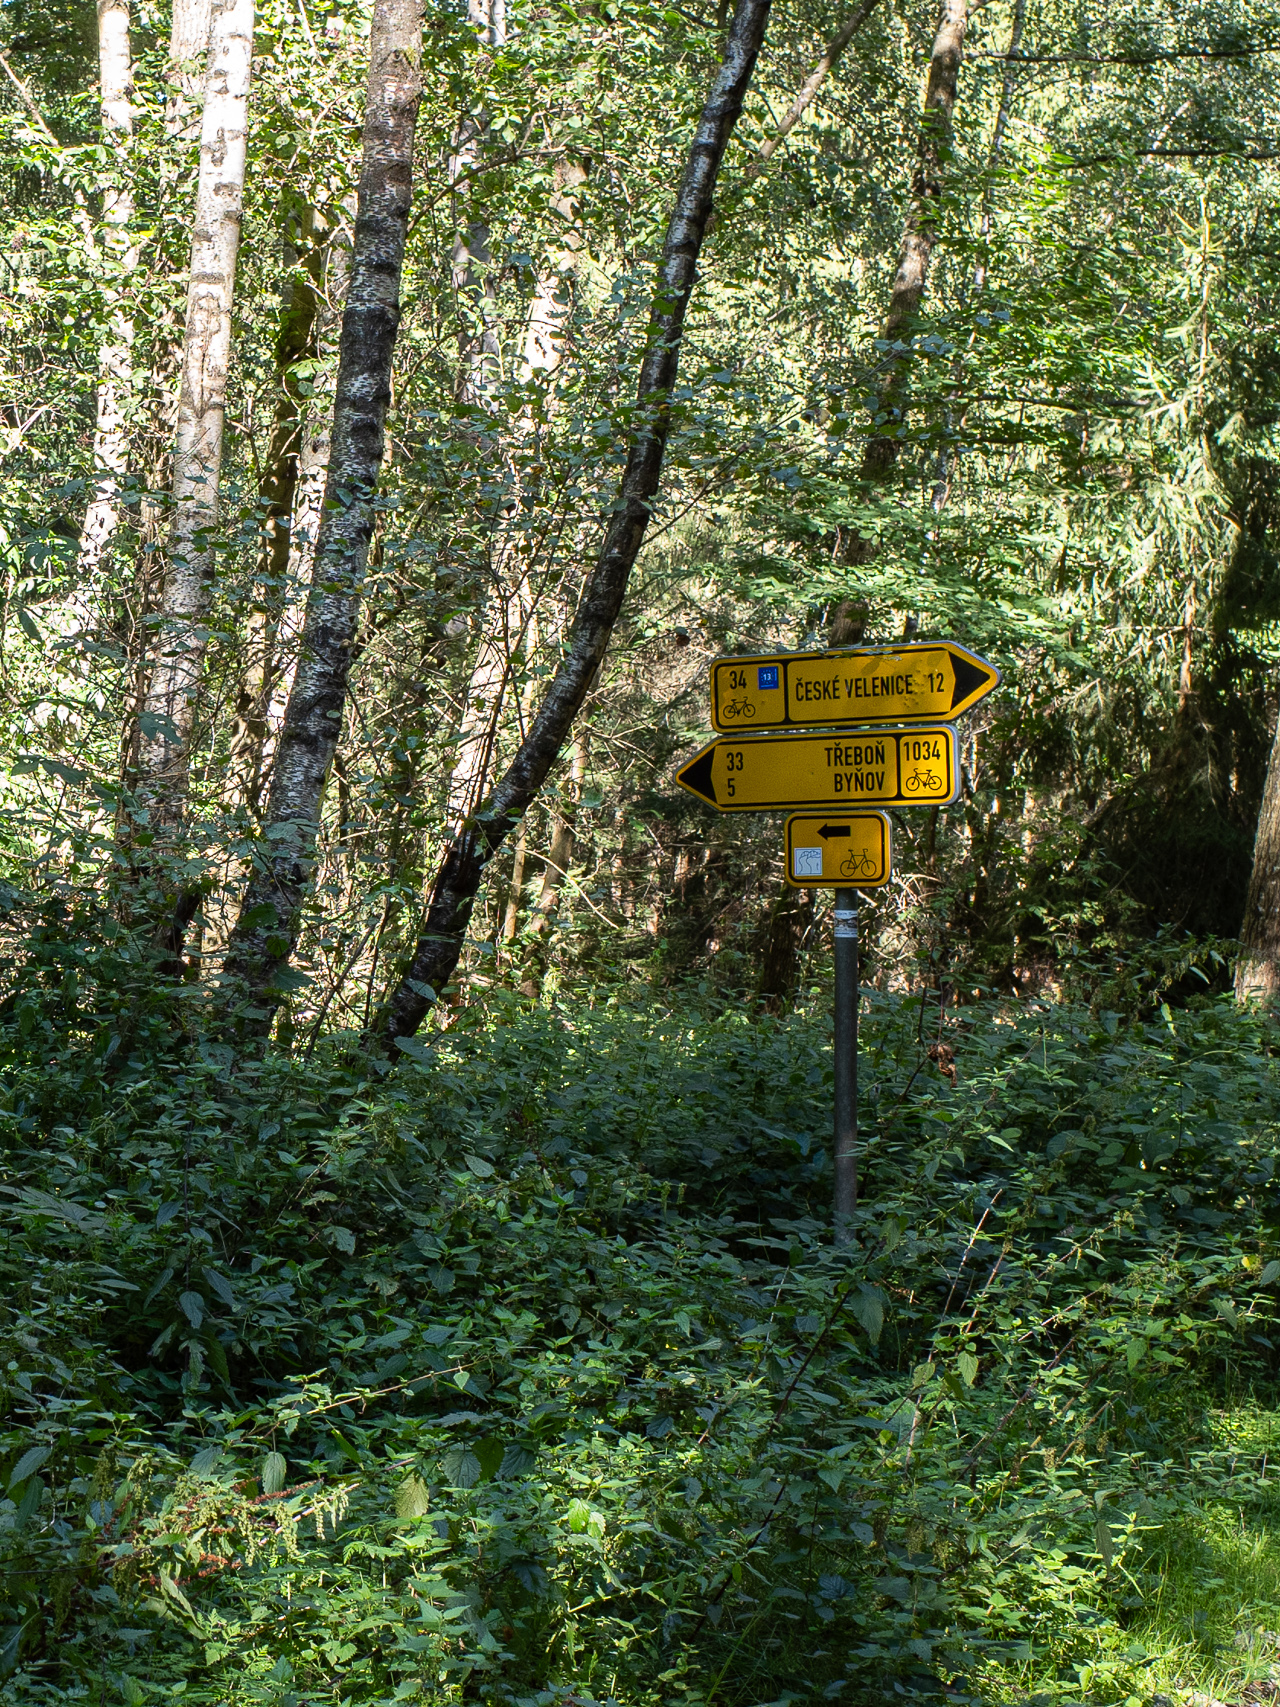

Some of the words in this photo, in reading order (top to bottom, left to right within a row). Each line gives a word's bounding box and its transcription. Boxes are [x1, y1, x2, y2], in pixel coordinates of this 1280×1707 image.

[729, 669, 747, 690] 34
[763, 673, 772, 681] 13
[795, 675, 841, 701] ČESKÉ
[844, 674, 914, 698] VELENICE
[927, 672, 945, 693] 12
[726, 751, 744, 772] 33
[824, 740, 885, 767] TŘEBOŇ
[903, 740, 941, 761] 1034
[727, 777, 736, 798] 5
[834, 767, 885, 793] BYŇOV
